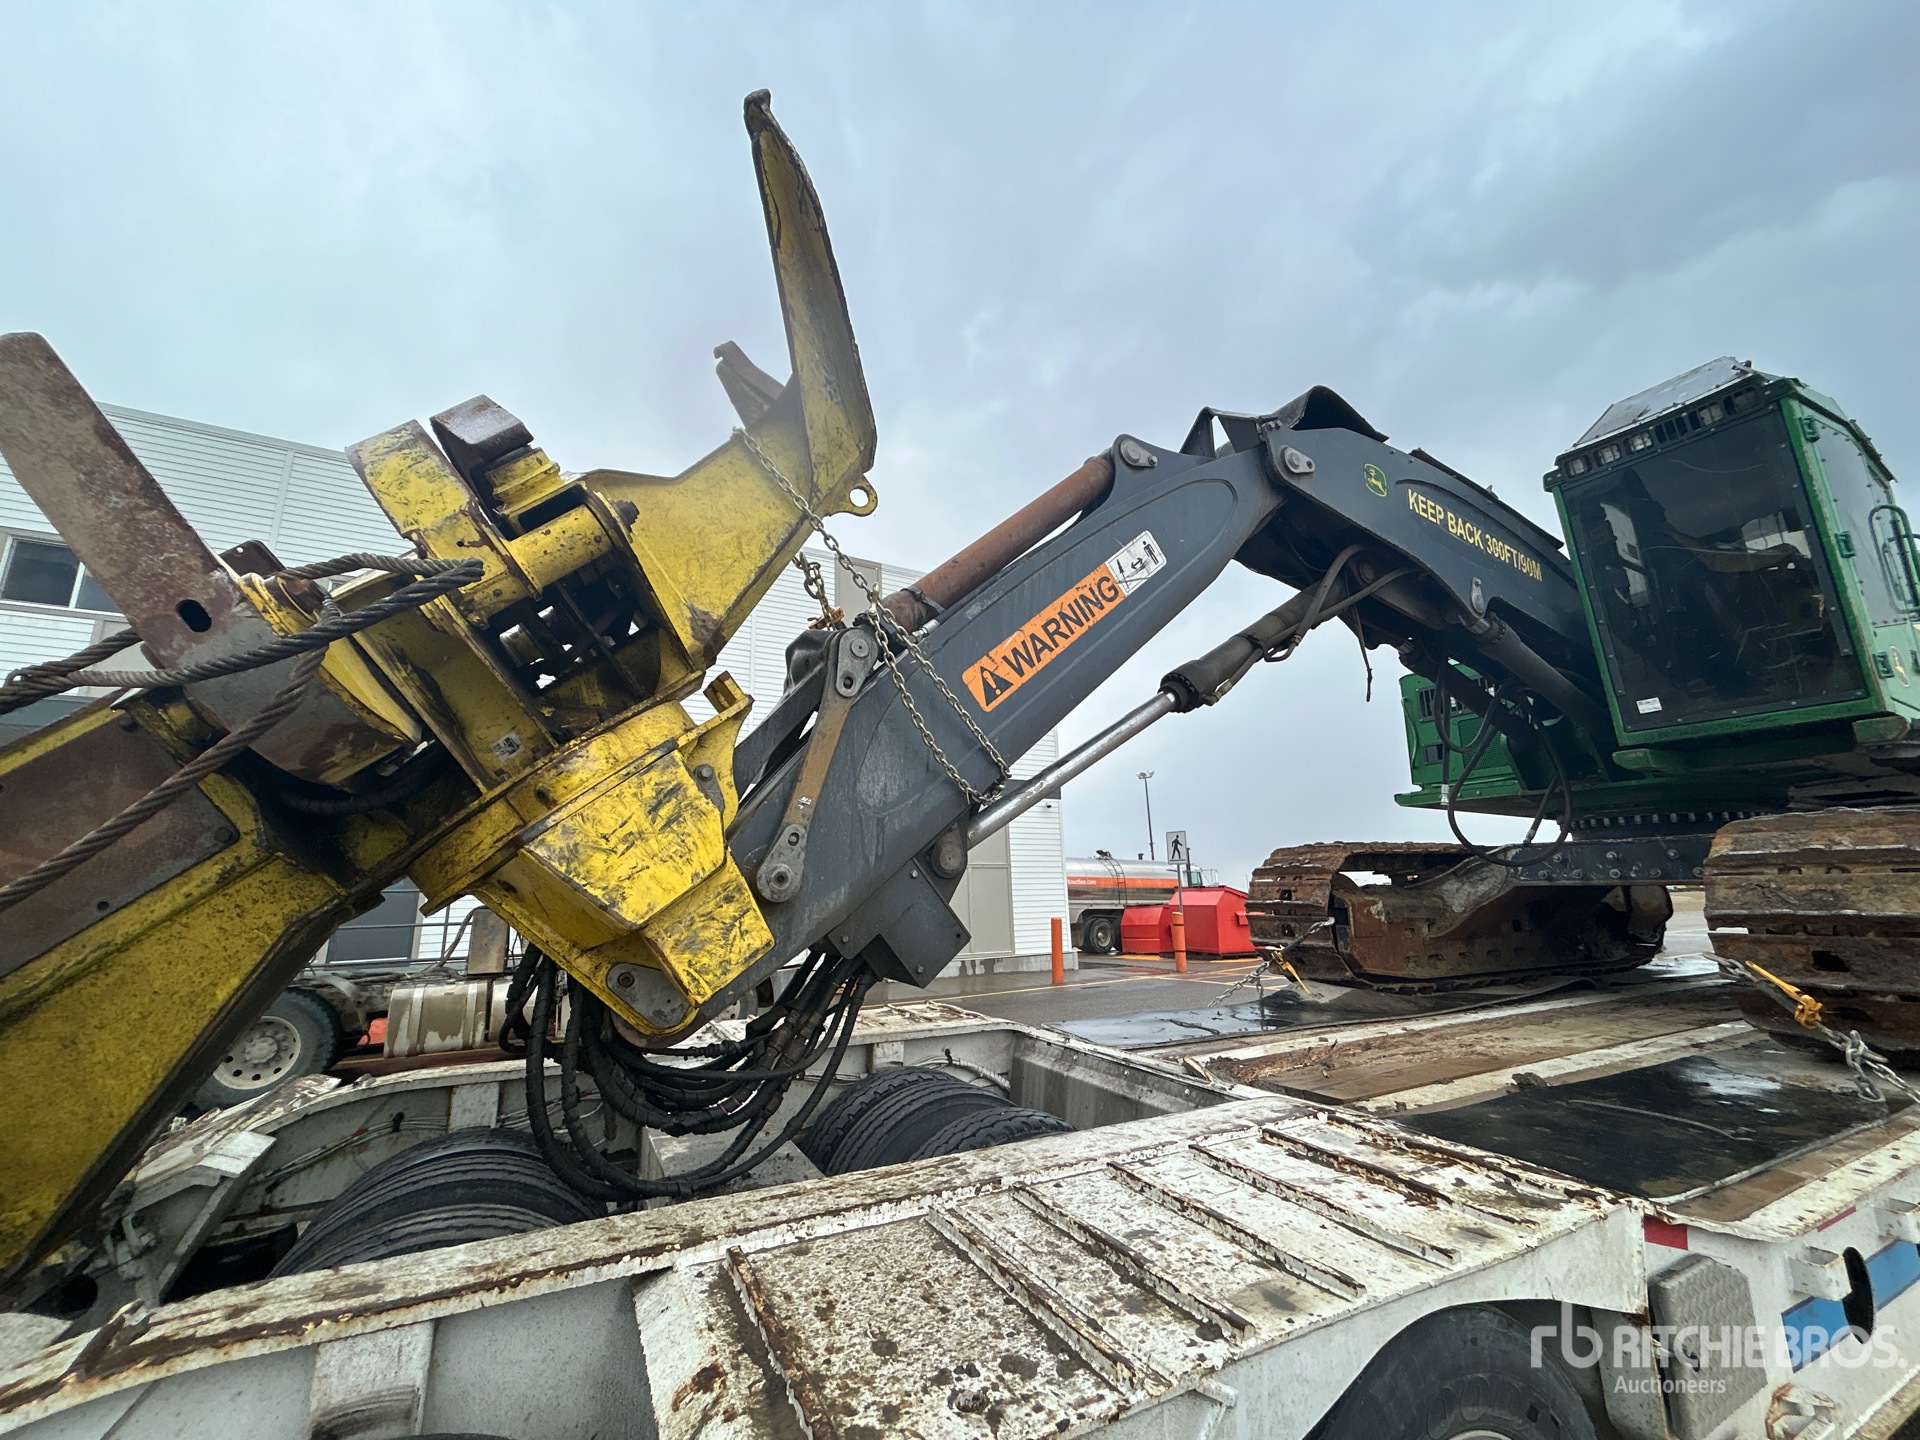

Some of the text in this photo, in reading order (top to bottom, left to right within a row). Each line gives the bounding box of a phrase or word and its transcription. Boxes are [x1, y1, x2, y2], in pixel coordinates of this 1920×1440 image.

[1408, 489, 1445, 525] KEEP
[1447, 511, 1484, 550] BACK
[1001, 575, 1120, 678] WARNING
